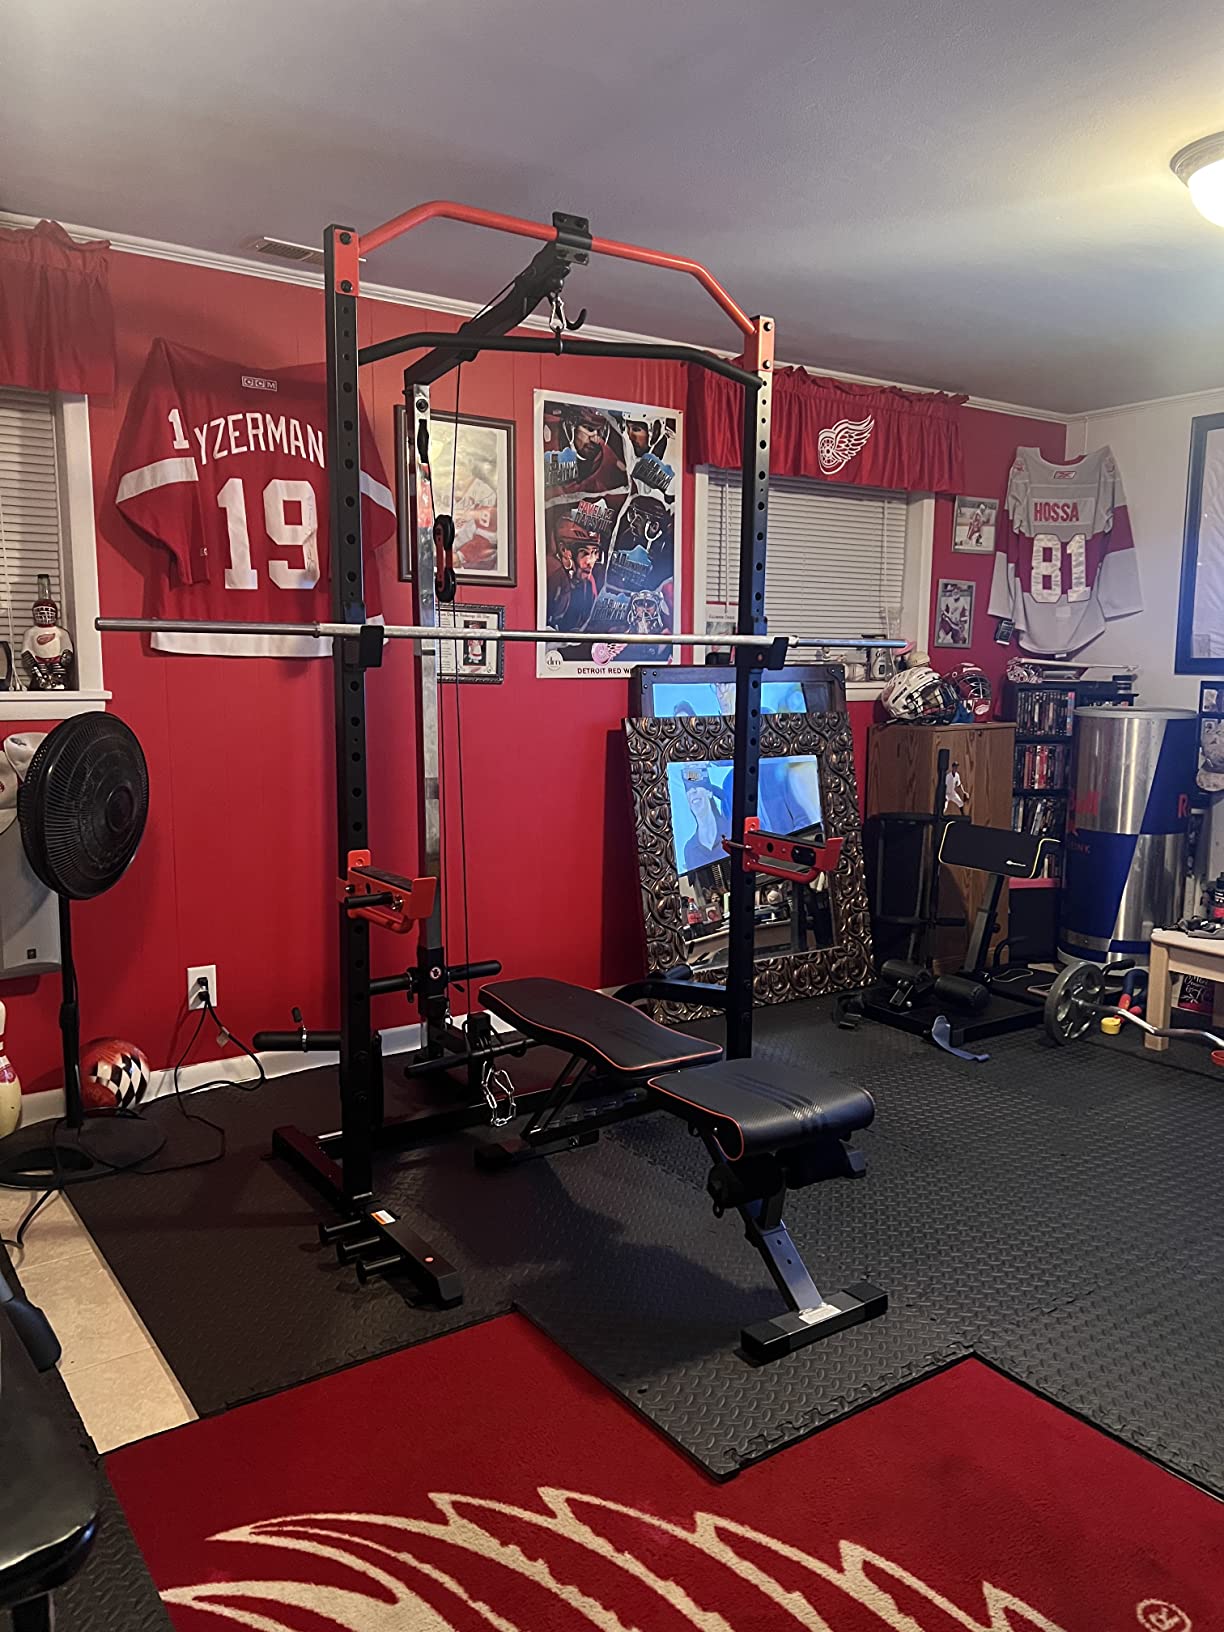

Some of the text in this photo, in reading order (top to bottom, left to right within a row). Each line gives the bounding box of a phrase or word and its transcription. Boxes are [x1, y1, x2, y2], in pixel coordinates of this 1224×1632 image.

[243, 378, 277, 390] CCM
[194, 412, 325, 469] YZERMAN
[1034, 502, 1079, 522] HOSSA
[217, 478, 320, 590] 19
[1030, 533, 1091, 603] 81
[577, 667, 606, 675] DETROIT
